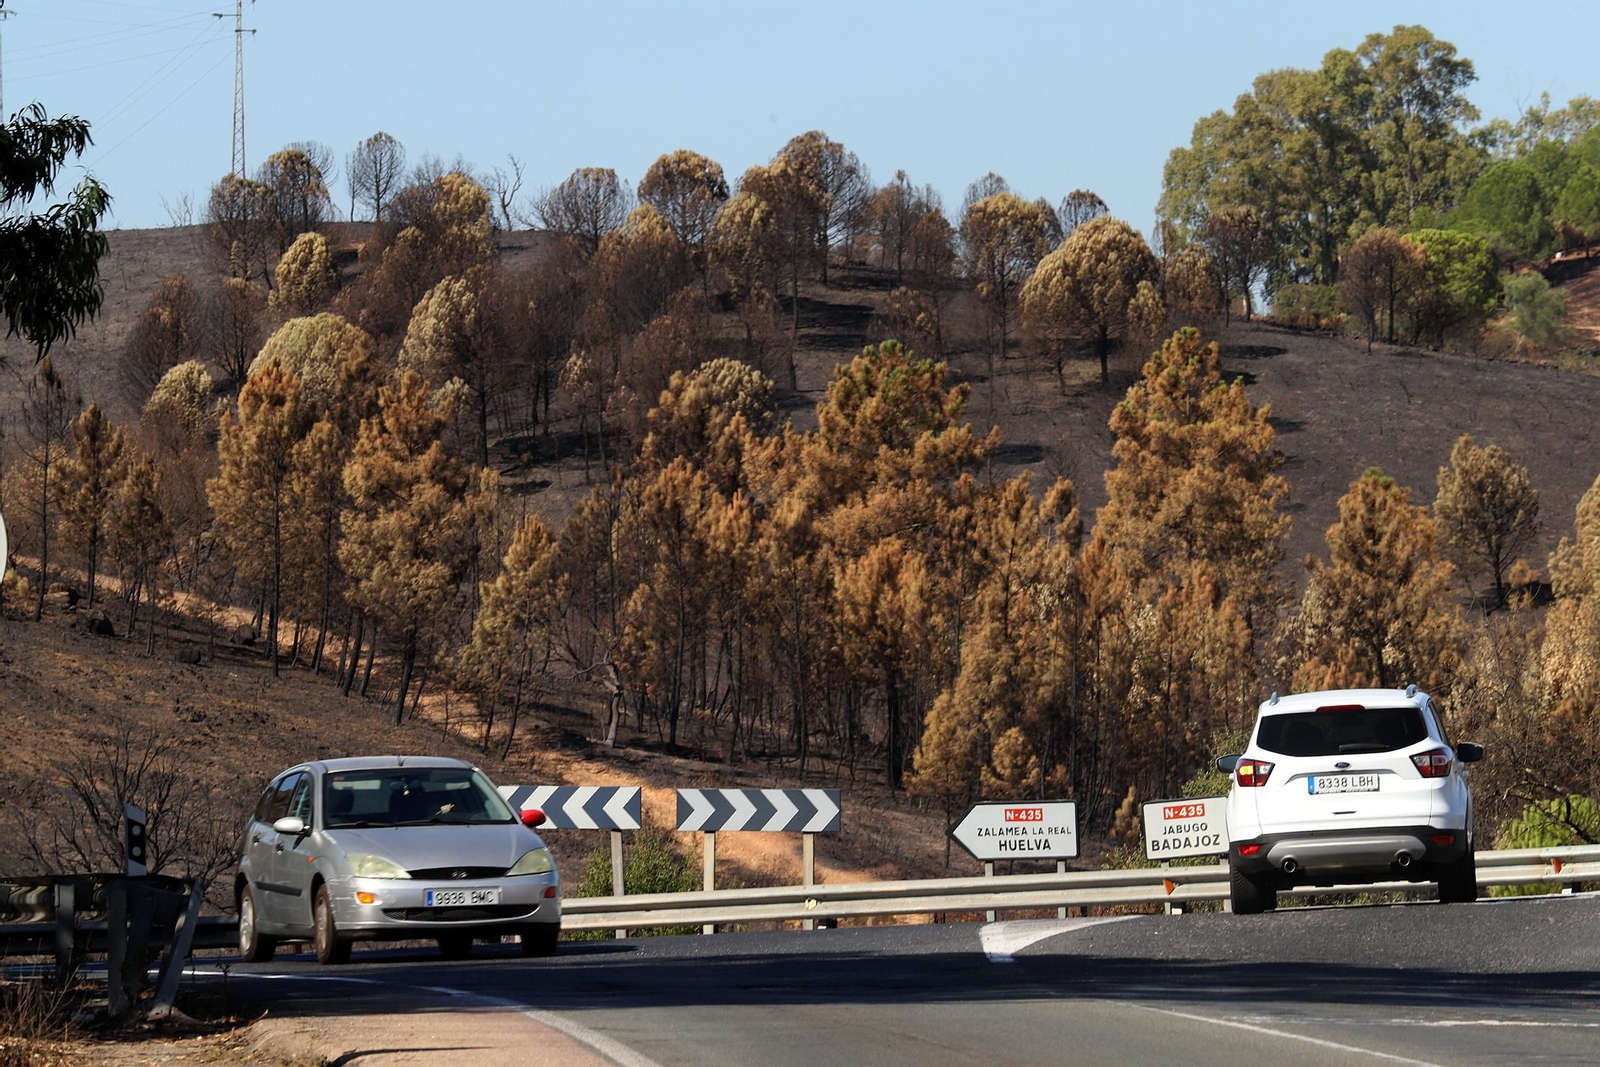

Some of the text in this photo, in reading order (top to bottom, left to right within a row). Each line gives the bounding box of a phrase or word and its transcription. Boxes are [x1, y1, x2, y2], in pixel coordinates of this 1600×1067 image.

[1318, 776, 1374, 789] 8338 LBH
[1006, 809, 1042, 821] N-435
[1164, 805, 1204, 819] N-435
[977, 826, 1072, 836] ZALAMEA LA REAL
[1162, 822, 1208, 835] JABUGO
[998, 838, 1051, 851] HUELVA
[1151, 834, 1221, 852] BADAJOZ
[435, 891, 465, 905] 9936
